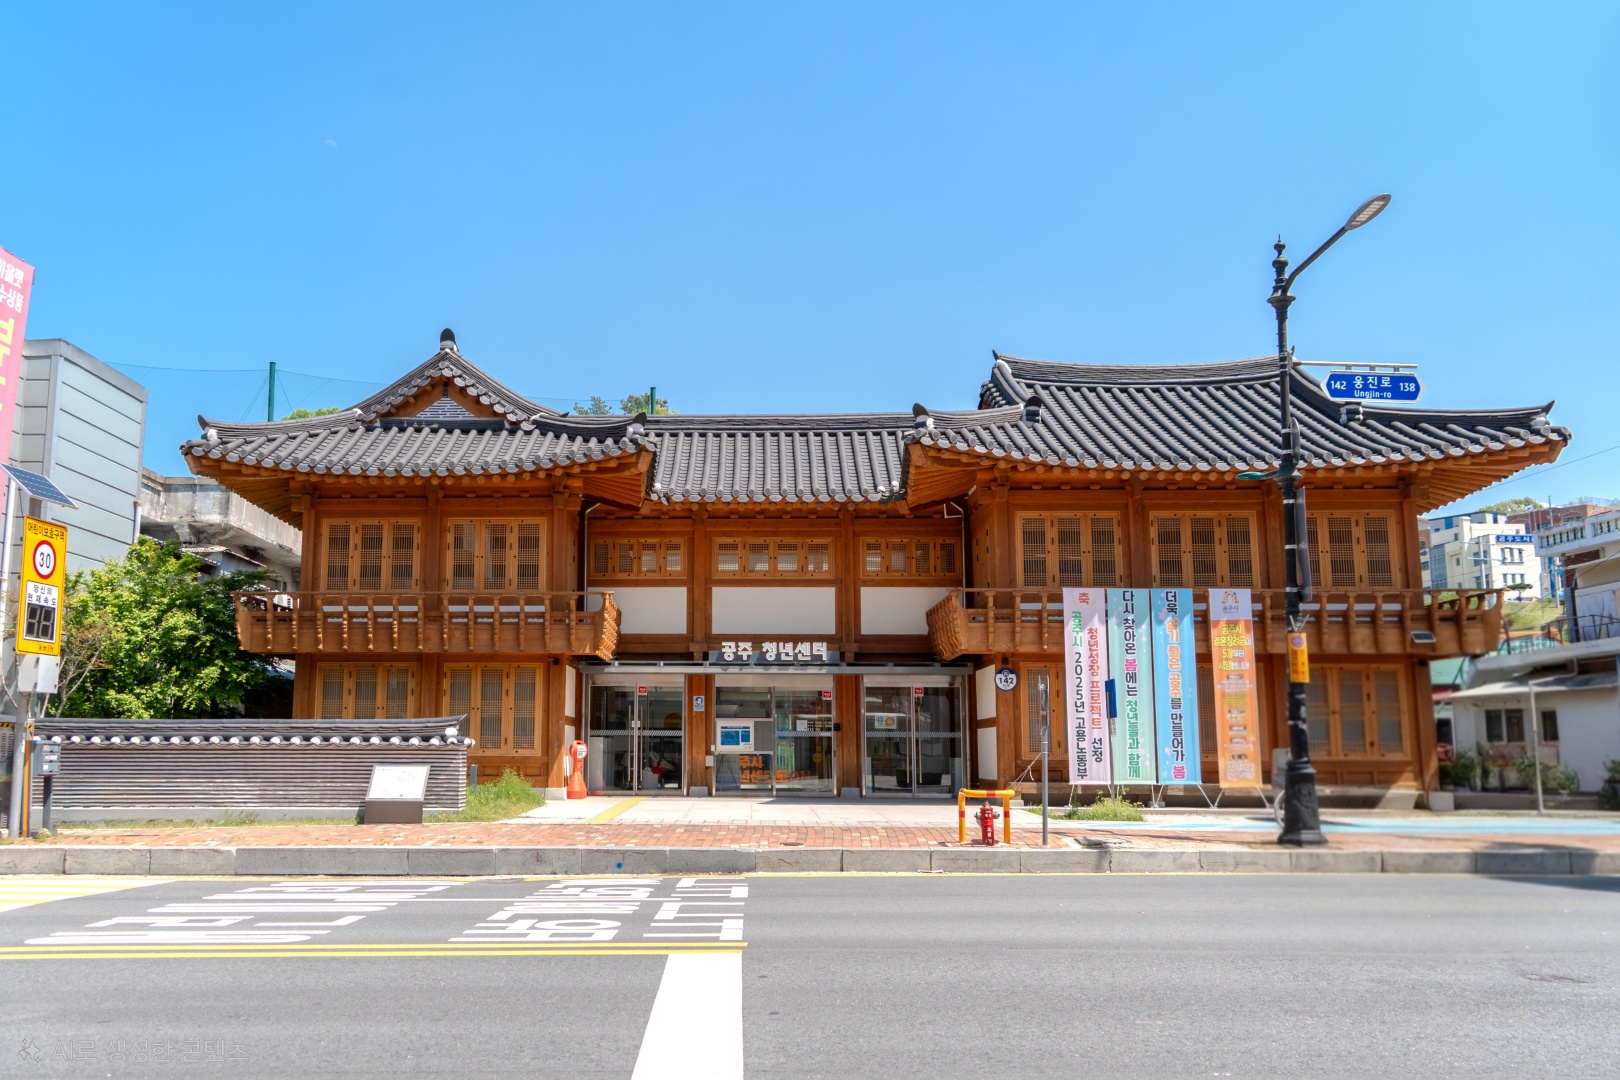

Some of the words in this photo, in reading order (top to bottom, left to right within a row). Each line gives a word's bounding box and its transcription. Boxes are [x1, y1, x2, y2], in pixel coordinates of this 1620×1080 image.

[1330, 380, 1347, 390] 142
[1353, 376, 1392, 389] 웅진로
[1399, 382, 1416, 392] 138
[1354, 389, 1392, 399] Ungjin-ro
[28, 522, 65, 542] 어린이보호구역
[38, 552, 51, 569] 30
[34, 584, 53, 596] 당신의
[1079, 592, 1090, 605] 축
[1122, 590, 1135, 614] 다시
[1165, 591, 1178, 615] 더욱
[1071, 611, 1083, 648] 공주시
[1123, 618, 1137, 655] 찾아온
[1166, 618, 1180, 642] 살기
[1221, 623, 1242, 635] 공주시
[39, 644, 54, 653] km/h
[721, 641, 753, 661] 공주
[762, 641, 828, 661] 청년센터
[1087, 627, 1100, 677] 청년성장
[1167, 645, 1181, 671] 좋은
[998, 677, 1014, 685] 142
[1074, 652, 1085, 713] 2025년
[1125, 658, 1138, 696] 봄에는
[1169, 673, 1182, 710] 공주를
[1089, 680, 1103, 730] 프로젝트
[1126, 699, 1140, 749] 청년들과
[1075, 717, 1088, 779] 고용노동부
[1170, 713, 1185, 762] 만들어가
[1091, 737, 1103, 763] 선정
[1128, 752, 1141, 778] 함께
[1172, 765, 1186, 780] 봄
